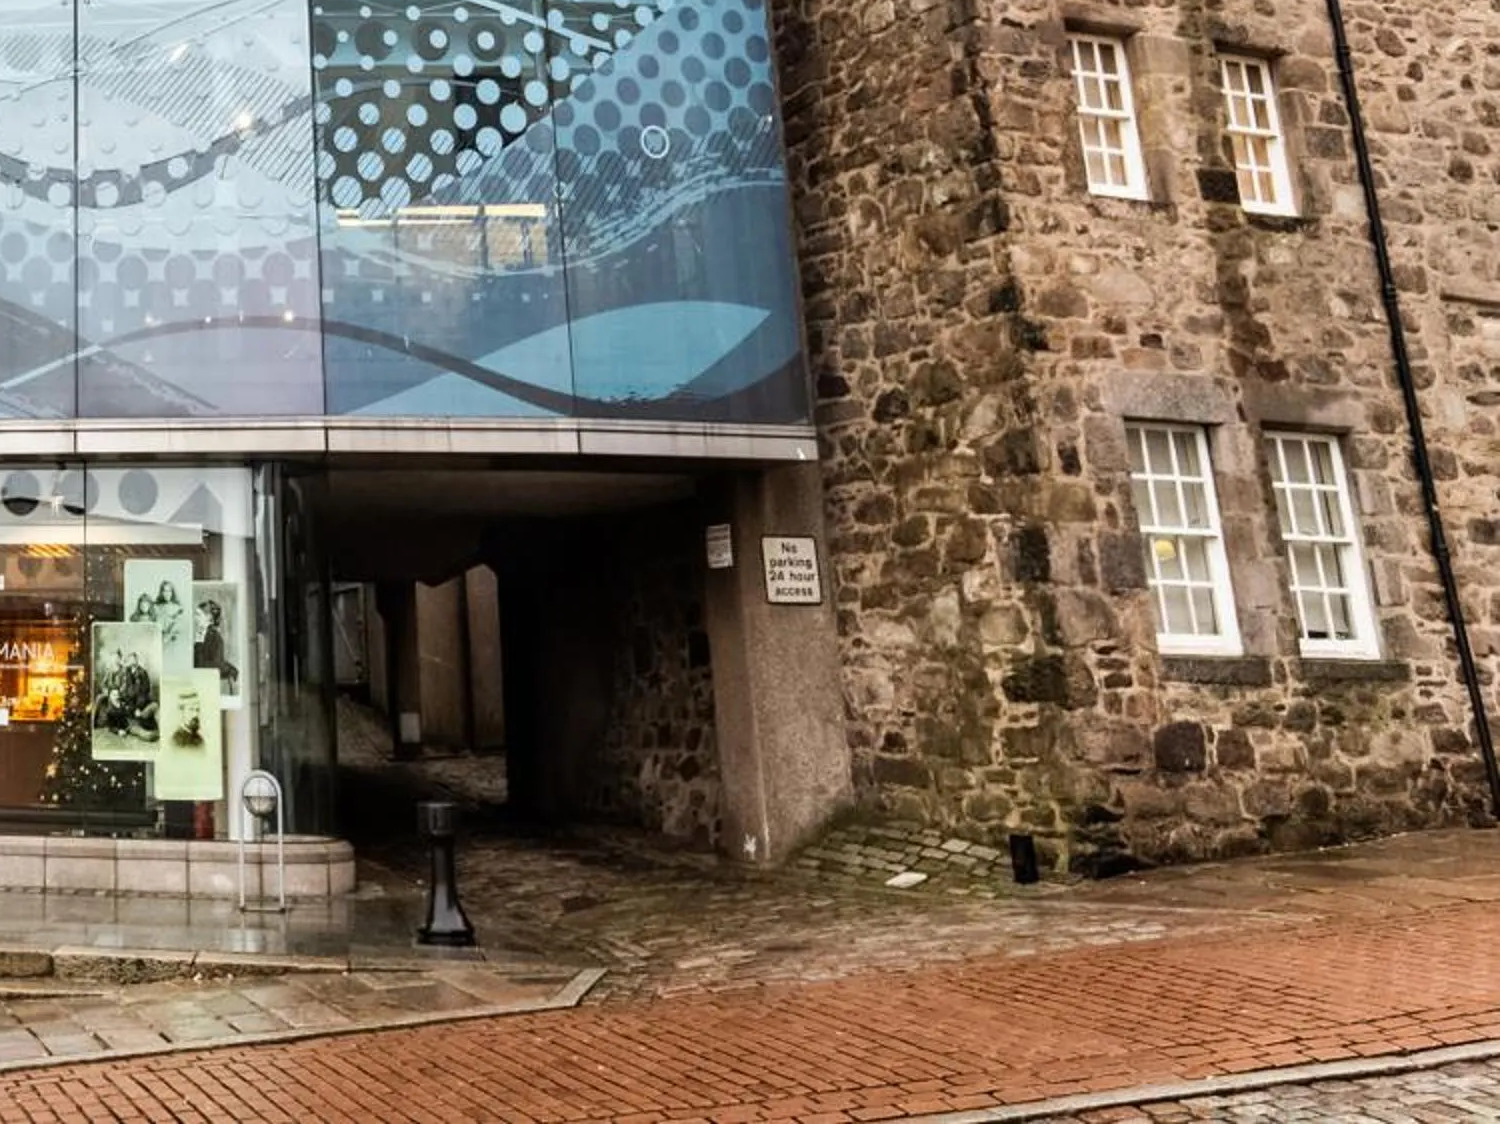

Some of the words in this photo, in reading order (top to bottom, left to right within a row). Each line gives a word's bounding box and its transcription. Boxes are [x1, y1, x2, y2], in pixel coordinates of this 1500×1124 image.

[781, 542, 798, 555] No
[770, 558, 813, 570] parking
[789, 571, 815, 582] hour
[775, 587, 813, 597] access
